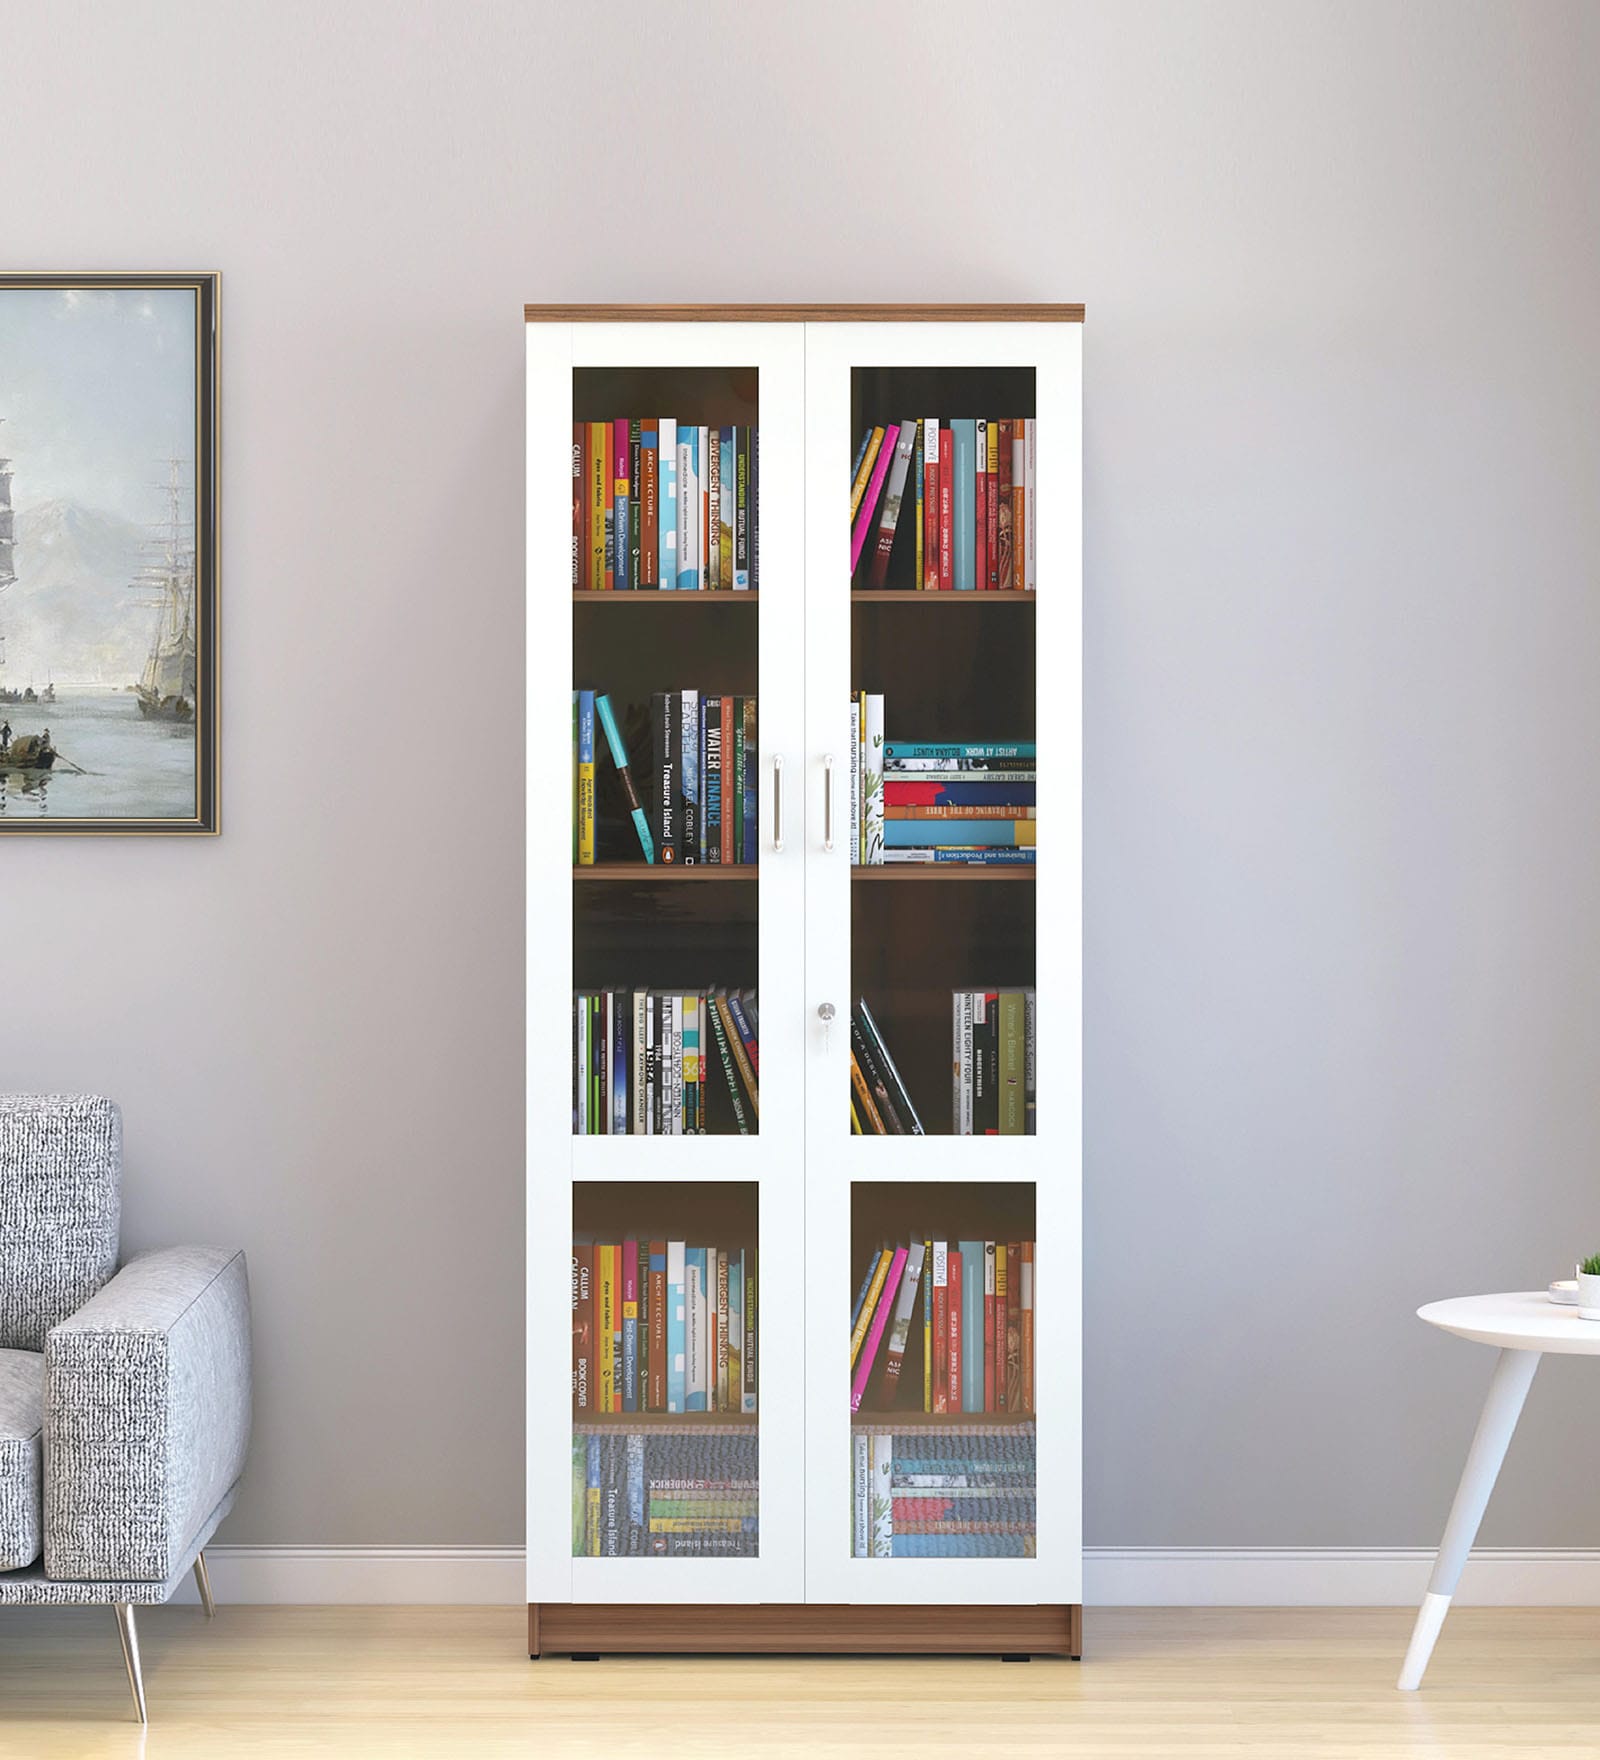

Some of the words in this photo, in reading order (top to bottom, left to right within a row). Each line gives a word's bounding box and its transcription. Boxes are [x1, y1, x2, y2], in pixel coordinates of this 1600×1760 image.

[928, 428, 937, 461] POSITIVE
[710, 438, 720, 494] DIVERGENT
[618, 497, 626, 534] Test-Driven
[710, 499, 720, 546] THINKING
[616, 534, 626, 577] Development
[682, 701, 690, 753] EARTH
[708, 728, 720, 769] WATER
[965, 747, 984, 756] WORK
[986, 747, 994, 756] AT
[995, 747, 1017, 756] ARTIST
[664, 763, 672, 806] Treasure
[686, 767, 694, 806] MICHAEL
[708, 773, 720, 827] FINANCE
[664, 808, 672, 837] Island
[686, 808, 694, 844] COBLEY
[926, 807, 947, 816] THREE
[966, 807, 974, 816] OF
[976, 807, 1006, 816] DRAWING
[1008, 807, 1022, 816] THE
[1007, 1003, 1016, 1038] Winter's
[1025, 1000, 1034, 1048] Savannah's
[864, 1052, 877, 1076] DESK
[1007, 1040, 1016, 1070] Blanket
[1025, 1051, 1034, 1081] Sunset
[580, 1267, 589, 1300] CALLUM
[936, 1251, 945, 1284] POSITIVE
[719, 1261, 728, 1316] DIVERGENT
[719, 1322, 728, 1368] THINKING
[624, 1356, 633, 1399] Development
[650, 1480, 693, 1489] RODERICK
[858, 1469, 867, 1497] nursing
[608, 1488, 618, 1527] Treasure
[608, 1530, 618, 1556] Island
[675, 1540, 701, 1550] Island
[703, 1540, 741, 1550] Treasure
